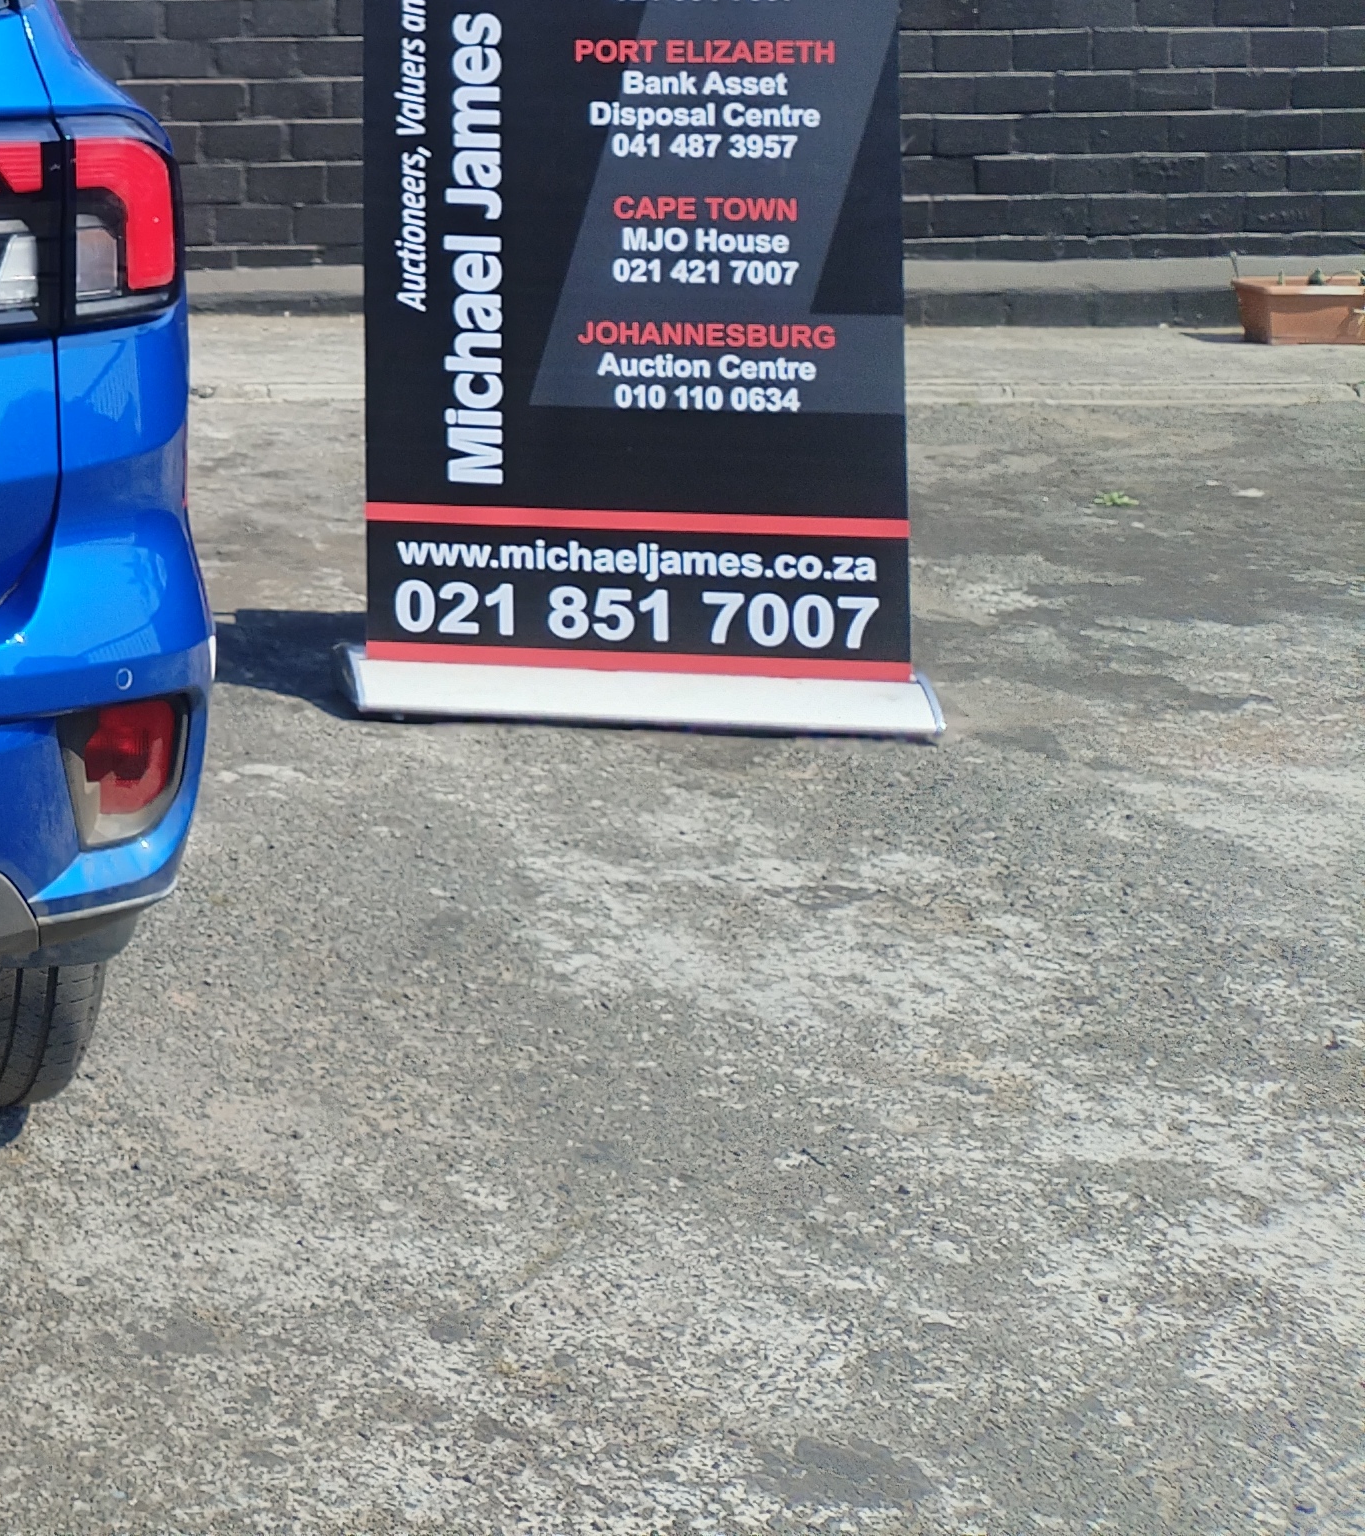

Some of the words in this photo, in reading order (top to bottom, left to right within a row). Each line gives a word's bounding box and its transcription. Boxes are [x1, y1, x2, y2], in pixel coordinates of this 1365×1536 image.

[574, 39, 658, 64] PORT
[666, 39, 835, 64] ELIZABETH
[393, 37, 426, 136] Valuers
[622, 70, 698, 95] Bank
[701, 70, 788, 96] Asset
[445, 12, 503, 220] James
[590, 101, 716, 132] Disposal
[722, 102, 821, 128] Centre
[611, 132, 660, 158] 041
[668, 133, 722, 158] 487
[728, 133, 798, 159] 3957
[613, 195, 697, 221] CAPE
[704, 197, 798, 222] TOWN
[394, 146, 432, 312] Auctioneers,
[622, 226, 689, 252] MJO
[695, 227, 790, 254] House
[612, 257, 661, 283] 021
[669, 259, 720, 284] 421
[729, 259, 800, 286] 7007
[578, 320, 836, 350] JOHANNESBURG
[443, 234, 504, 485] Michael
[596, 351, 711, 379] Auction
[717, 354, 817, 382] Centre
[614, 383, 667, 410] 010
[673, 385, 724, 411] 110
[729, 386, 801, 412] 0634
[396, 539, 877, 582] www.michaeljames.co.za
[395, 579, 514, 636] 021
[547, 585, 669, 642] 851
[702, 591, 880, 649] 7007
